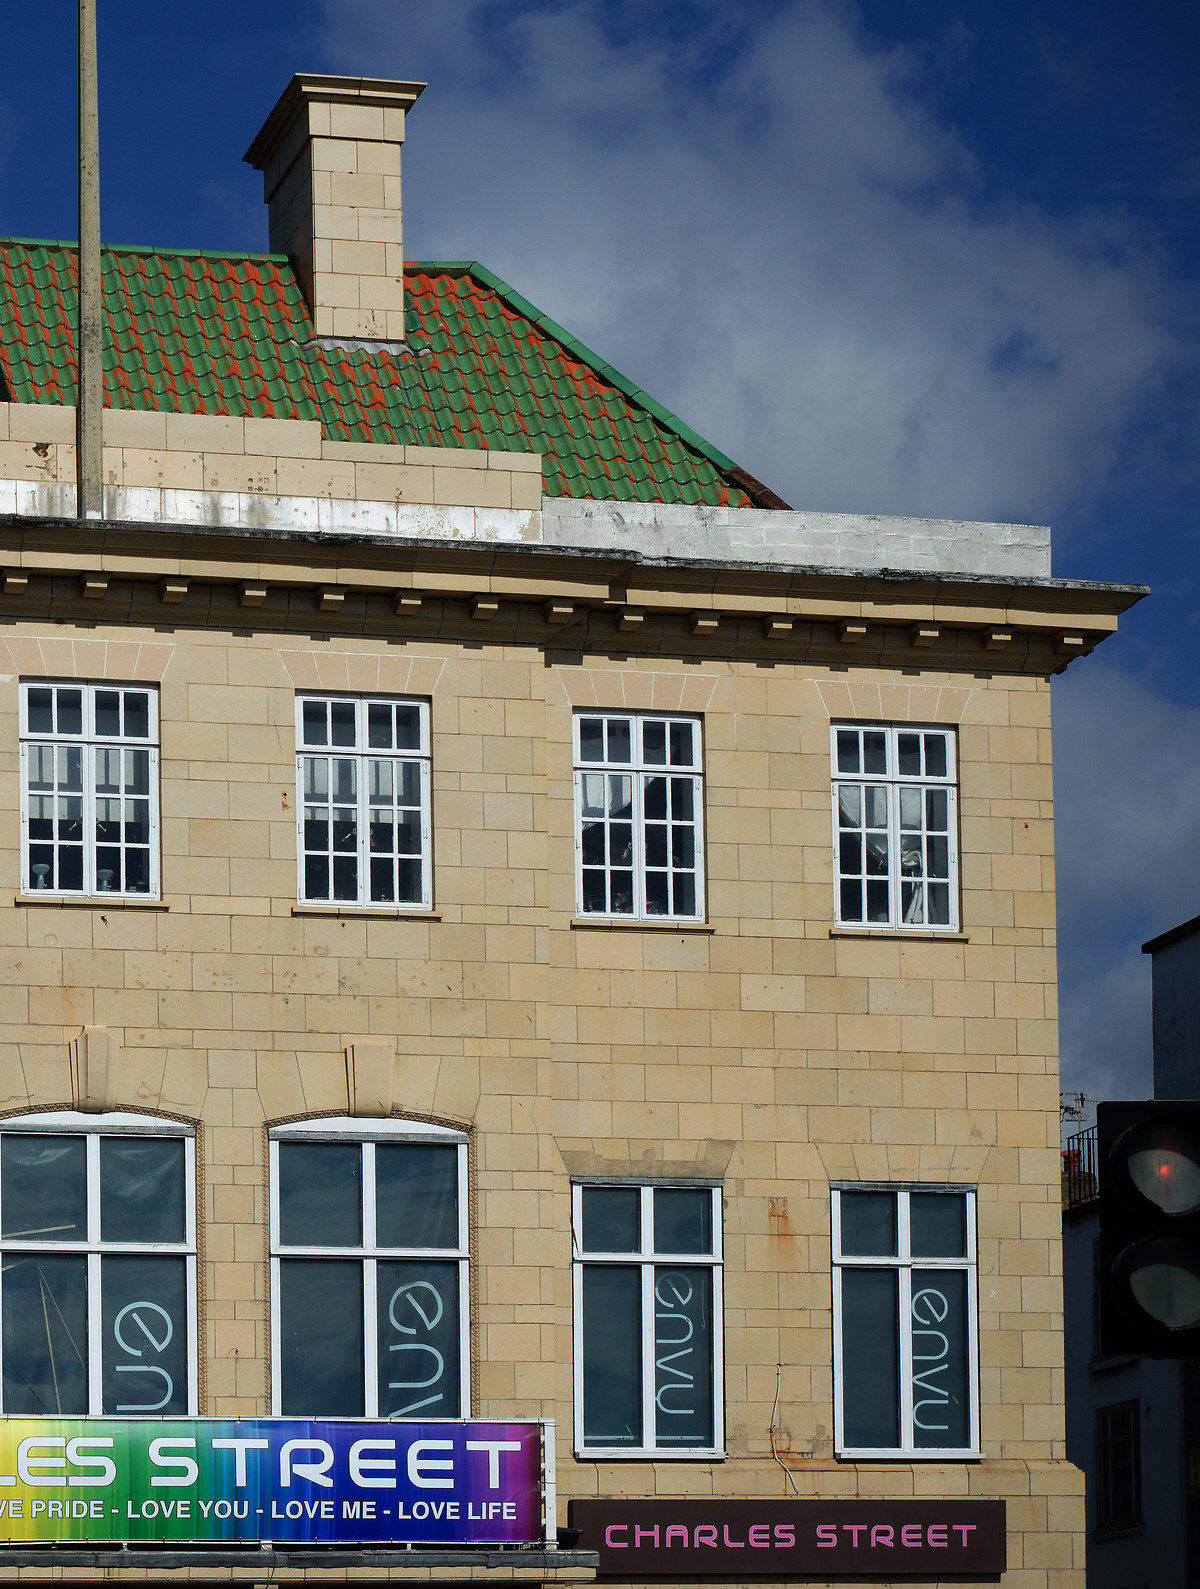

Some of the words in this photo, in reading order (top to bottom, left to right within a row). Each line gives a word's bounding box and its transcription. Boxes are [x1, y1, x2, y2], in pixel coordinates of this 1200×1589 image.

[147, 1437, 523, 1489] STREET
[31, 1499, 104, 1519] PRIDE
[126, 1499, 191, 1519] LOVE
[197, 1499, 250, 1519] YOU
[271, 1500, 336, 1520] LOVE
[342, 1500, 377, 1520] ME
[398, 1500, 460, 1520] LOVE
[467, 1501, 517, 1521] LIFE
[605, 1523, 796, 1549] CHARLES
[815, 1523, 977, 1549] STREET
